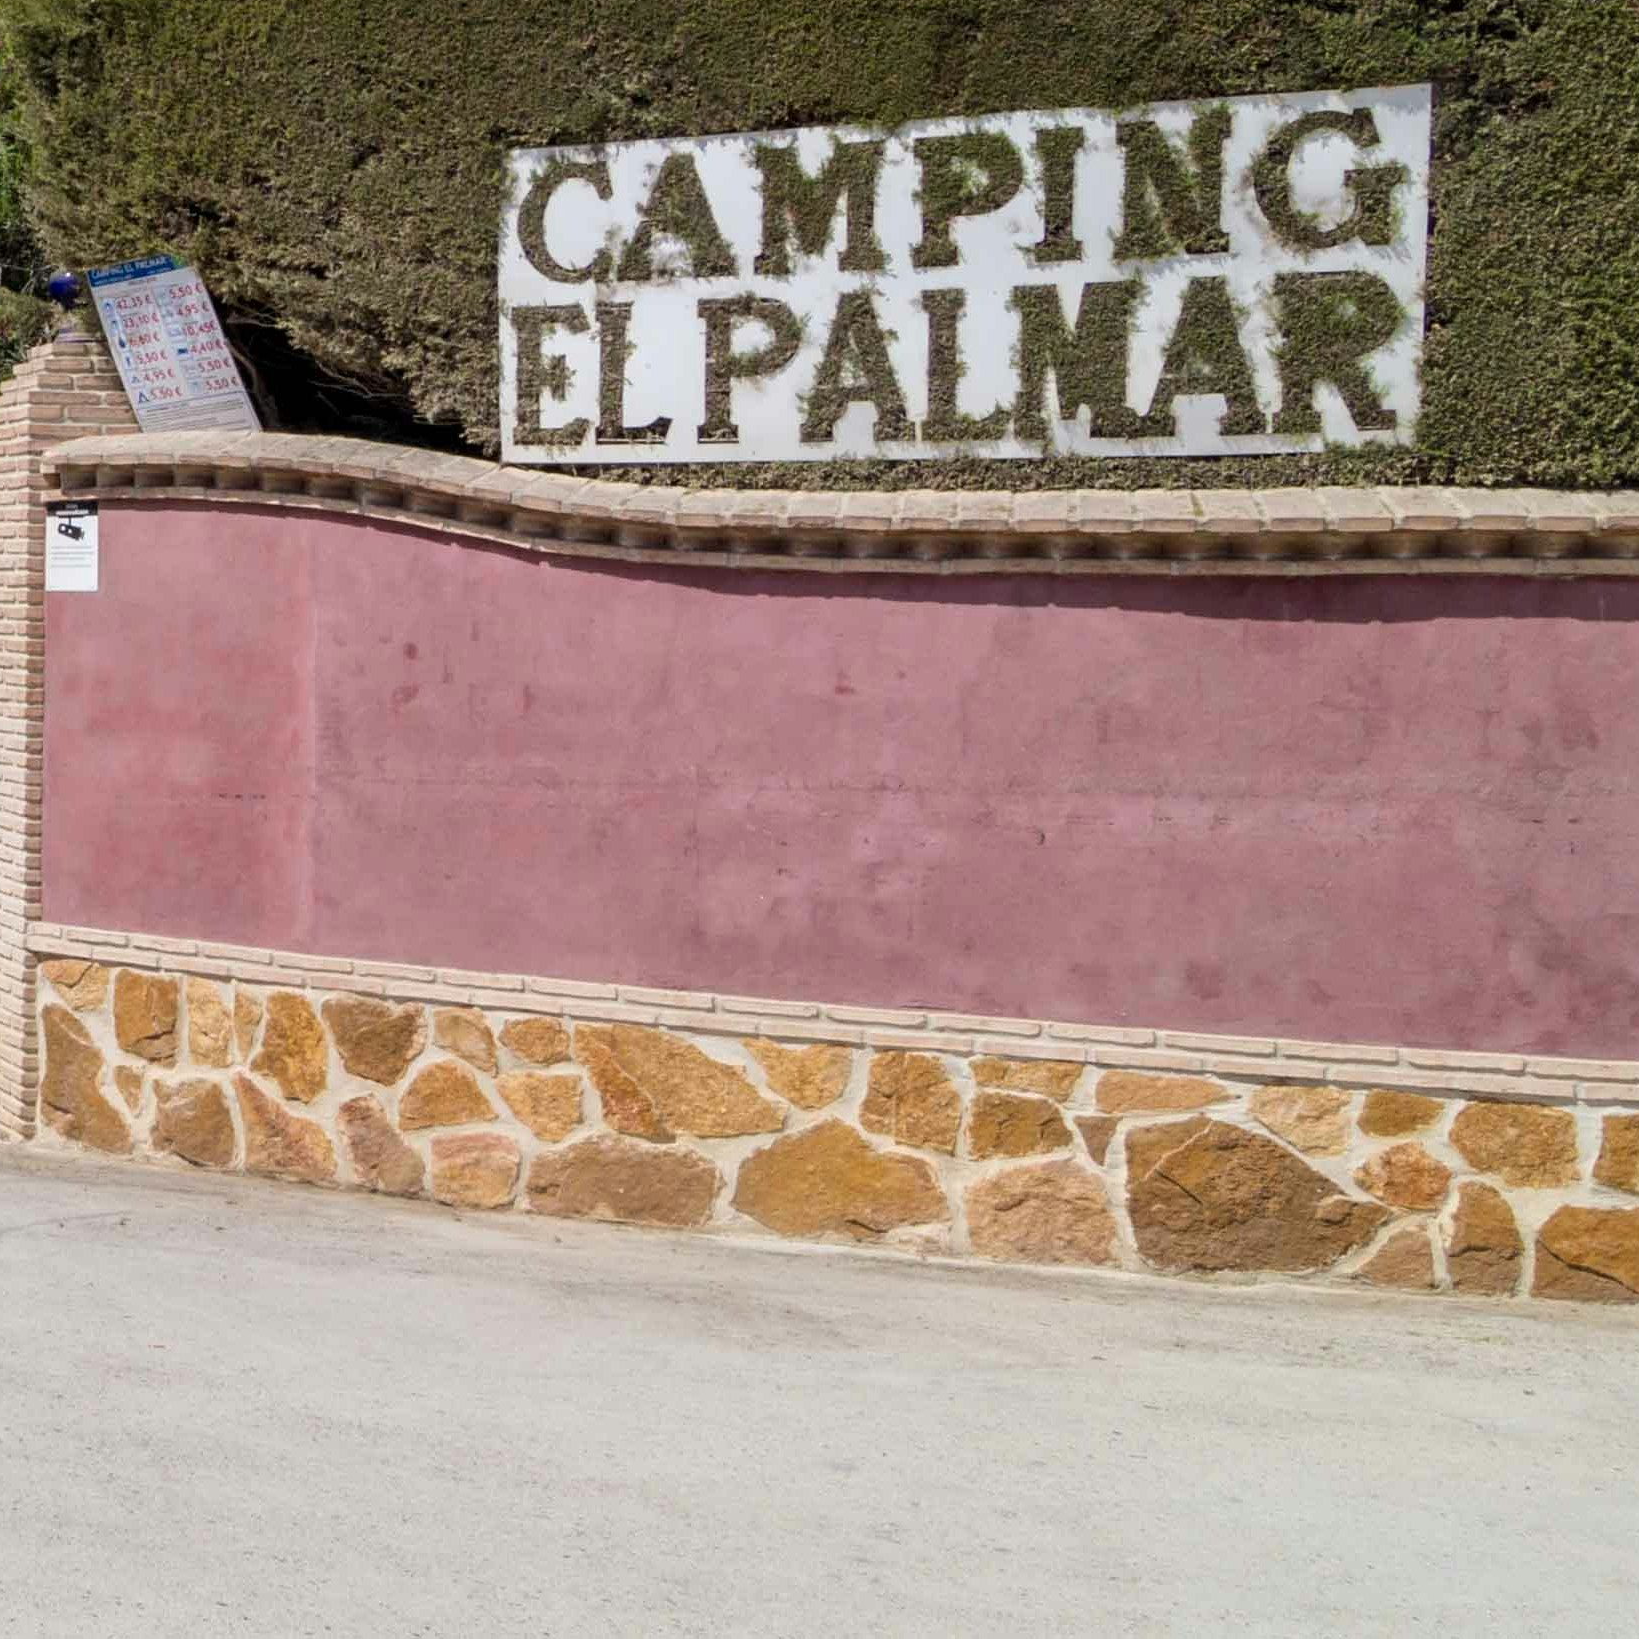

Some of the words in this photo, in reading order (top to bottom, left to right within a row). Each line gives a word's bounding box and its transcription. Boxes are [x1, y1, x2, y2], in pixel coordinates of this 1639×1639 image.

[516, 106, 1409, 283] CAMPING
[511, 300, 674, 445] EL
[695, 271, 1408, 445] PALMAR
